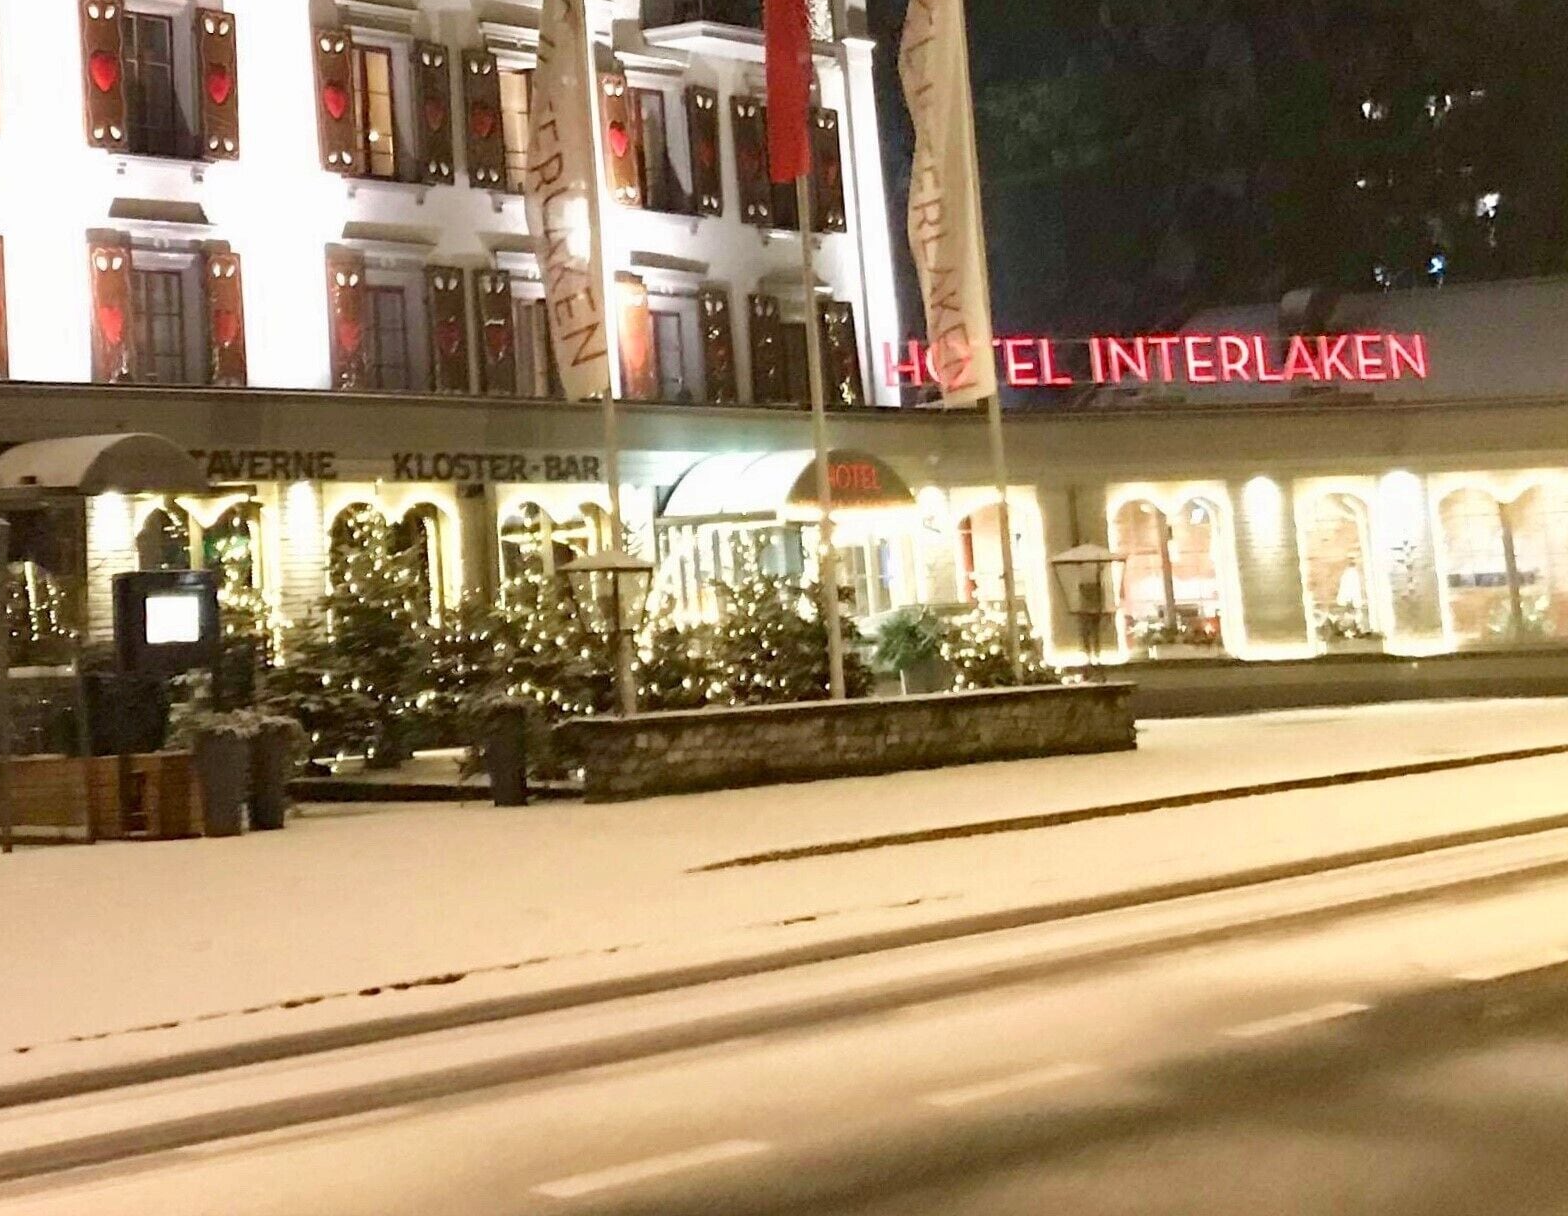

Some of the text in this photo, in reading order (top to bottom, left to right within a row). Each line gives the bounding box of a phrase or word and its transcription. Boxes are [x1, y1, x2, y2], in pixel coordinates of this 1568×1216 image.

[882, 334, 1427, 386] HOEL INTERLAKEN
[392, 451, 600, 481] KLOSTER-BAR
[826, 462, 881, 490] HOTEL
